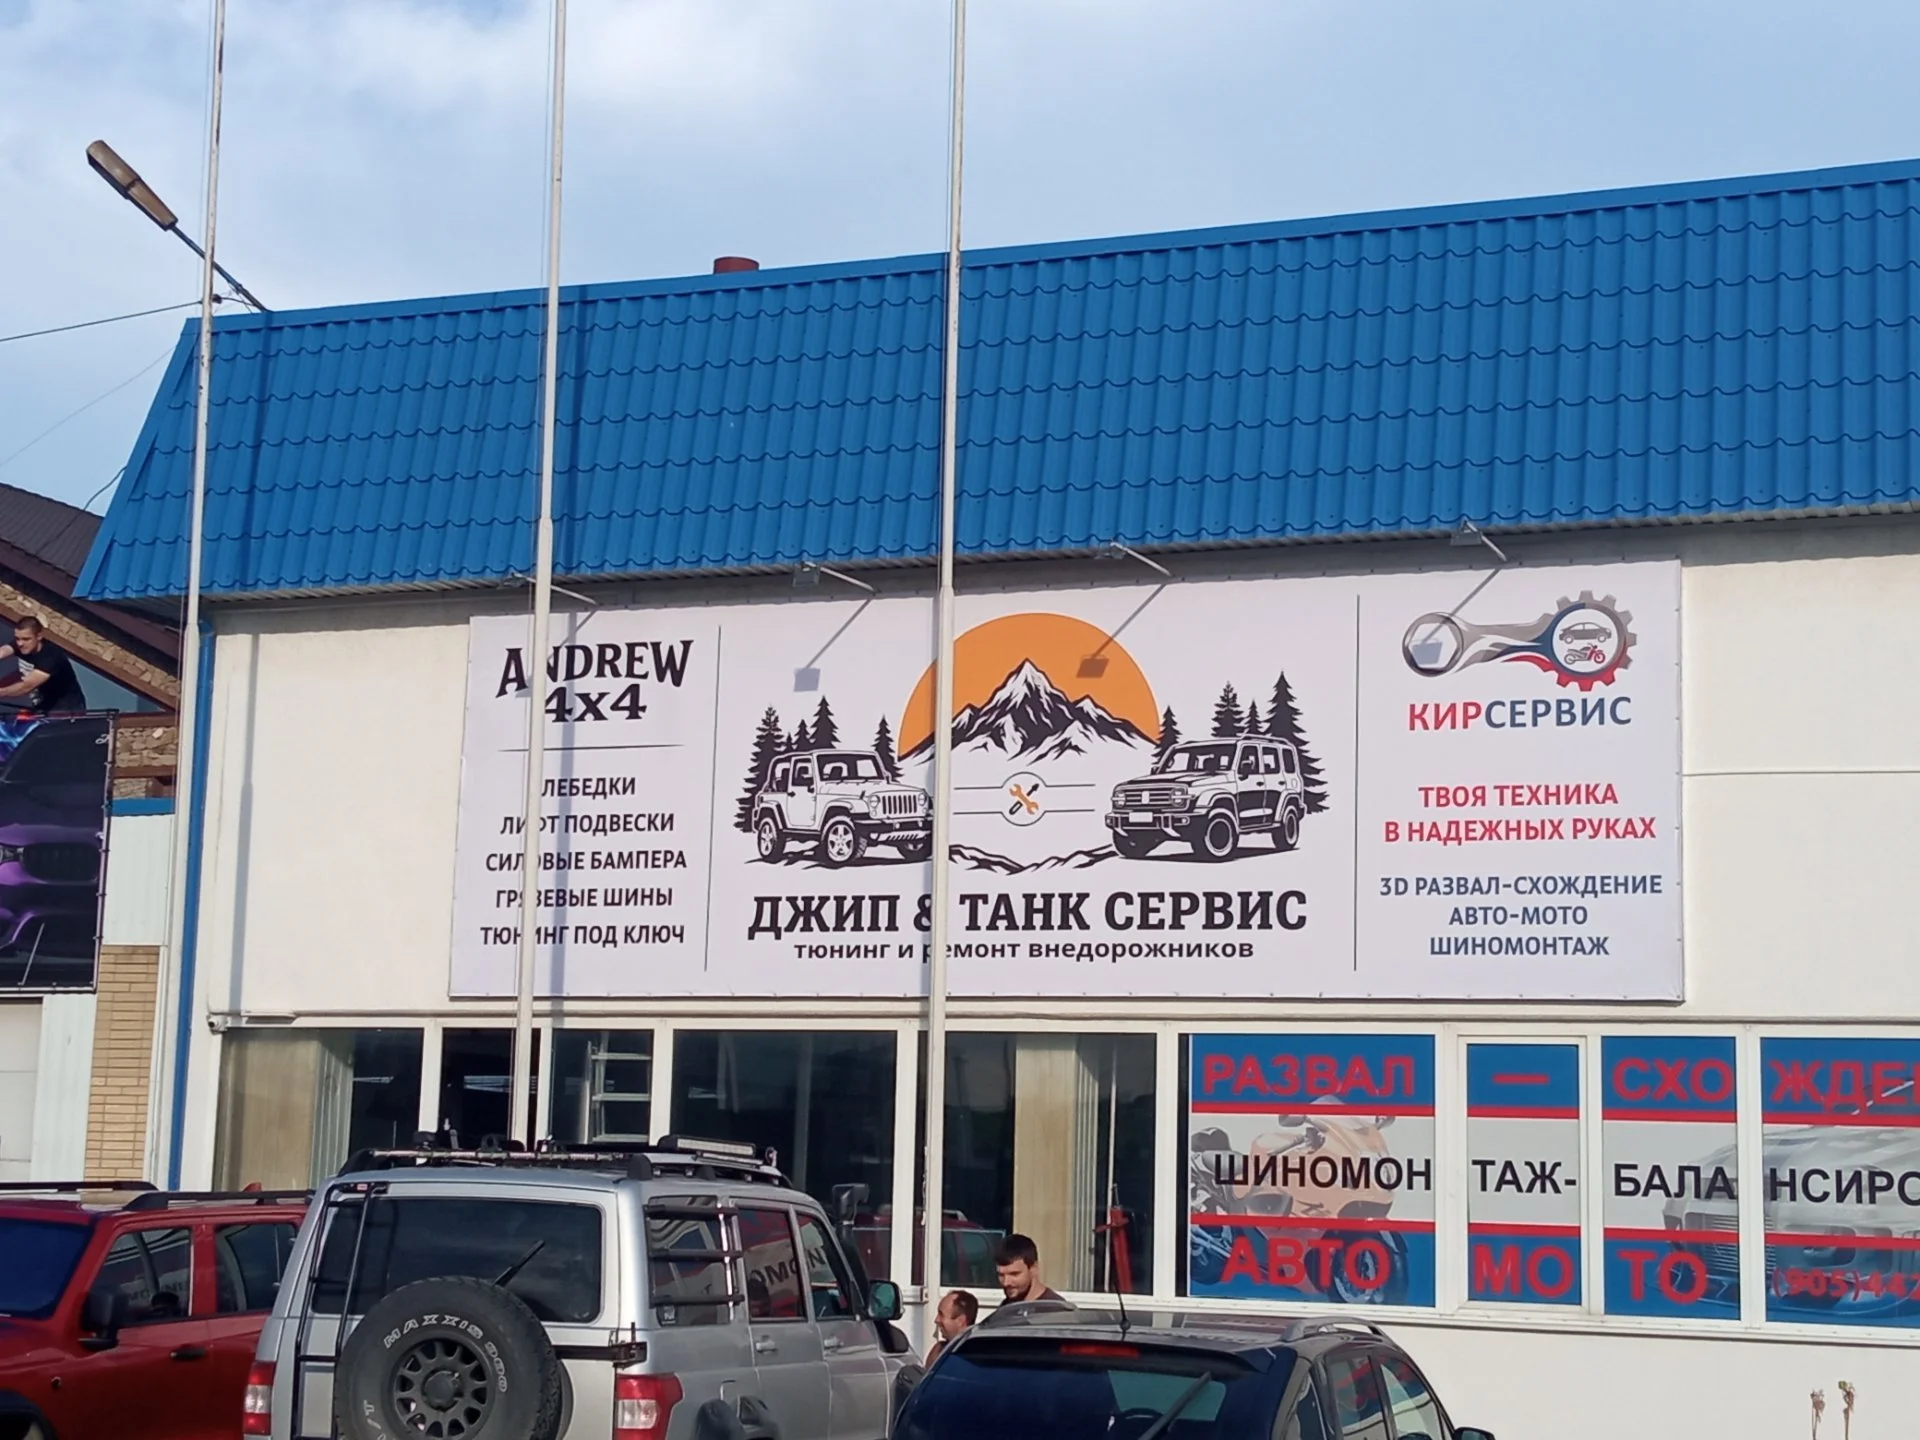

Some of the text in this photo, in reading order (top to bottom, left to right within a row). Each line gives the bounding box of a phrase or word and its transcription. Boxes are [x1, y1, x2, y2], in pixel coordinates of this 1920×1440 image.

[544, 684, 648, 723] 4x4
[1408, 697, 1632, 731] КИРСЕРВИС
[541, 777, 636, 799] ЛЕБЕДКИ
[1418, 783, 1619, 808] ТВОЯ ТЕХНИКА
[564, 813, 675, 836] ПОДВЕСКИ
[1384, 817, 1656, 846] В НАДЕЖНЫХ РУКАХ
[485, 850, 688, 872] СИЛВЫЕ БАМПЕРА
[604, 887, 673, 907] ШИНЫ
[1380, 875, 1663, 898] 3D РАЗВАЛ-СХОЖДЕНИЕ
[747, 894, 901, 940] ДЖИП
[958, 892, 1091, 932] ТАНК
[1103, 890, 1307, 932] СЕРВИС
[1449, 905, 1588, 926] АВТО-МОТО
[574, 926, 618, 948] ПОД
[623, 925, 685, 945] КЛЮЧ
[1429, 936, 1610, 956] ШИНОМОНТАЖ
[794, 943, 891, 959] тюнинг
[898, 943, 914, 959] и
[1029, 940, 1254, 963] внедорожников
[1202, 1054, 1415, 1097] РАЗВАЛ
[1612, 1056, 1734, 1101] СХО
[1214, 1154, 1920, 1206] ШИНОМОН ТАЖ- БАЛА НСИРО
[1220, 1236, 1708, 1304] АВТО МО ТО
[384, 1314, 484, 1349] MAXXIS
